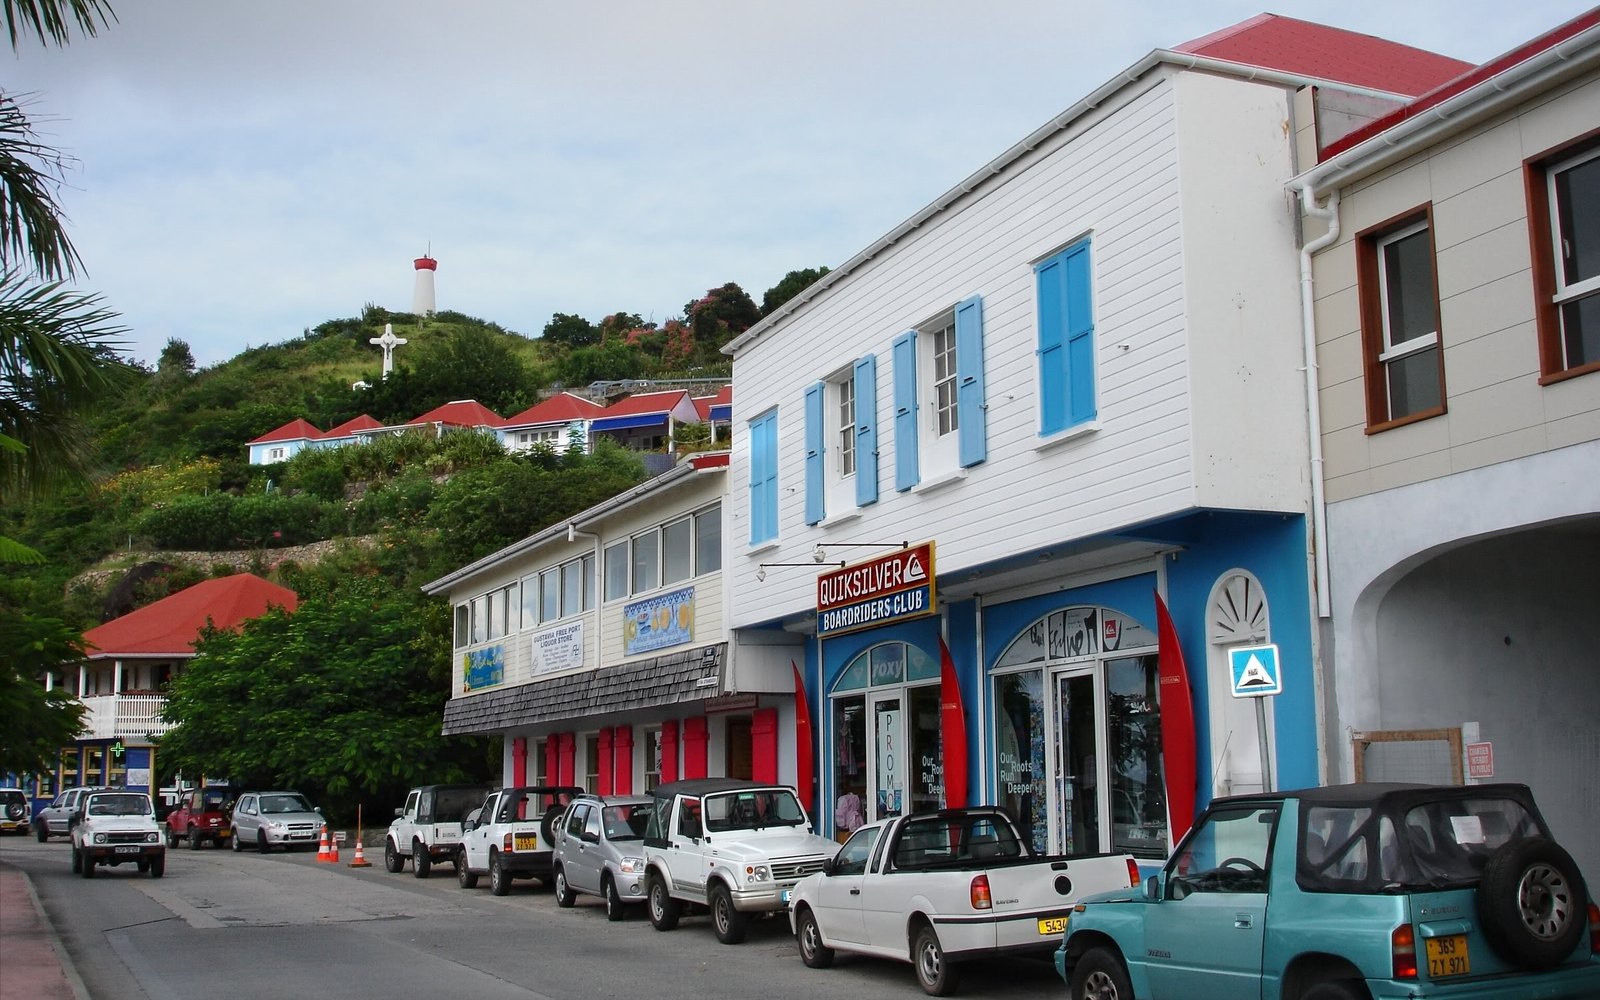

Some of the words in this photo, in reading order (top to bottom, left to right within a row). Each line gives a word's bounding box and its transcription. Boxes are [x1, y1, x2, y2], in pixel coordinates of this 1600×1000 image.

[820, 559, 902, 605] QUIKSILVER
[824, 598, 891, 631] BOARDRIDERS
[894, 590, 922, 614] CLUB
[534, 632, 554, 643] GUSTAVIA
[556, 628, 568, 638] FREE
[569, 624, 581, 635] PORT
[541, 638, 557, 648] LIQUOR
[558, 634, 573, 644] STORE
[886, 714, 894, 810] PROMO
[922, 755, 933, 767] Our
[1000, 752, 1013, 764] Our
[1012, 760, 1033, 772] Roots
[922, 772, 934, 783] Run
[1000, 770, 1014, 782] Run
[1008, 782, 1033, 796] Deeper
[1438, 938, 1455, 955] 369
[1432, 959, 1445, 975] ZY
[1449, 957, 1466, 973] 971
